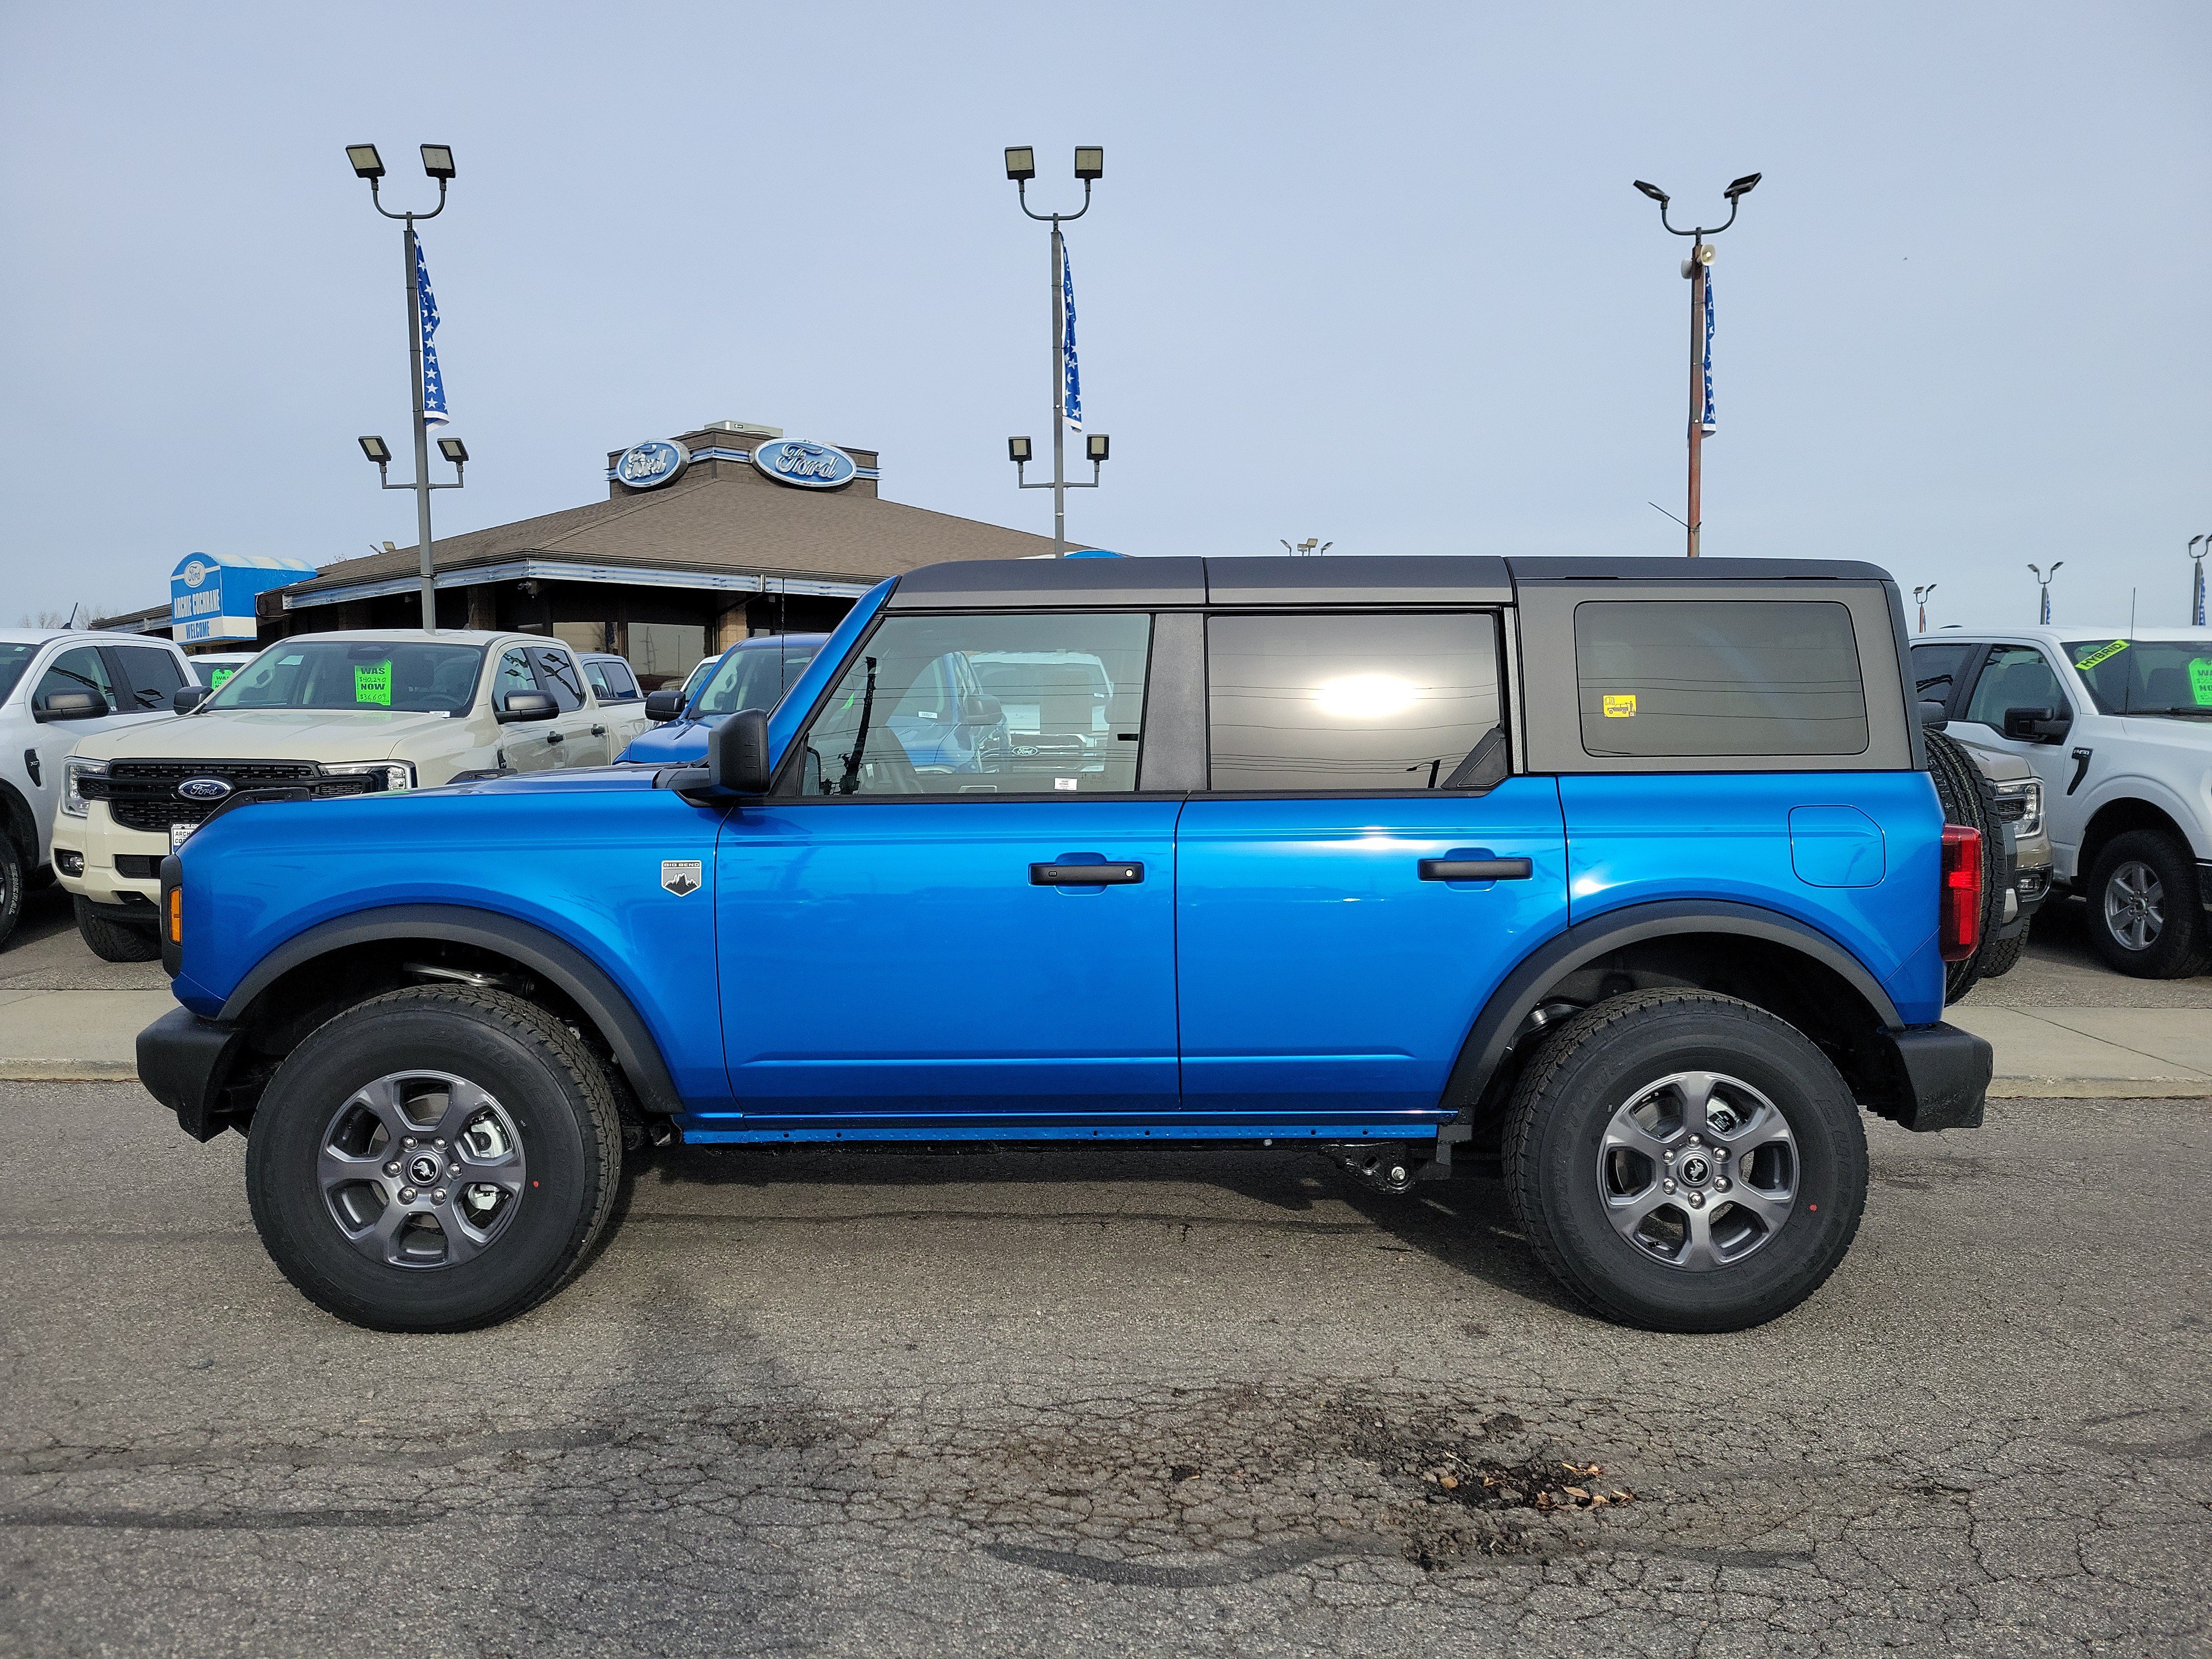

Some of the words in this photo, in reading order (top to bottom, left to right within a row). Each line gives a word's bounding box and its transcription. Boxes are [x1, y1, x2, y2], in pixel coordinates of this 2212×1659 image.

[775, 443, 839, 478] Ford
[188, 566, 201, 582] Ford
[174, 595, 192, 619] ARCHIE
[193, 589, 220, 616] COCHRANE
[185, 620, 210, 639] WELCOME
[2080, 643, 2123, 667] HYBRID
[190, 783, 219, 795] Ford
